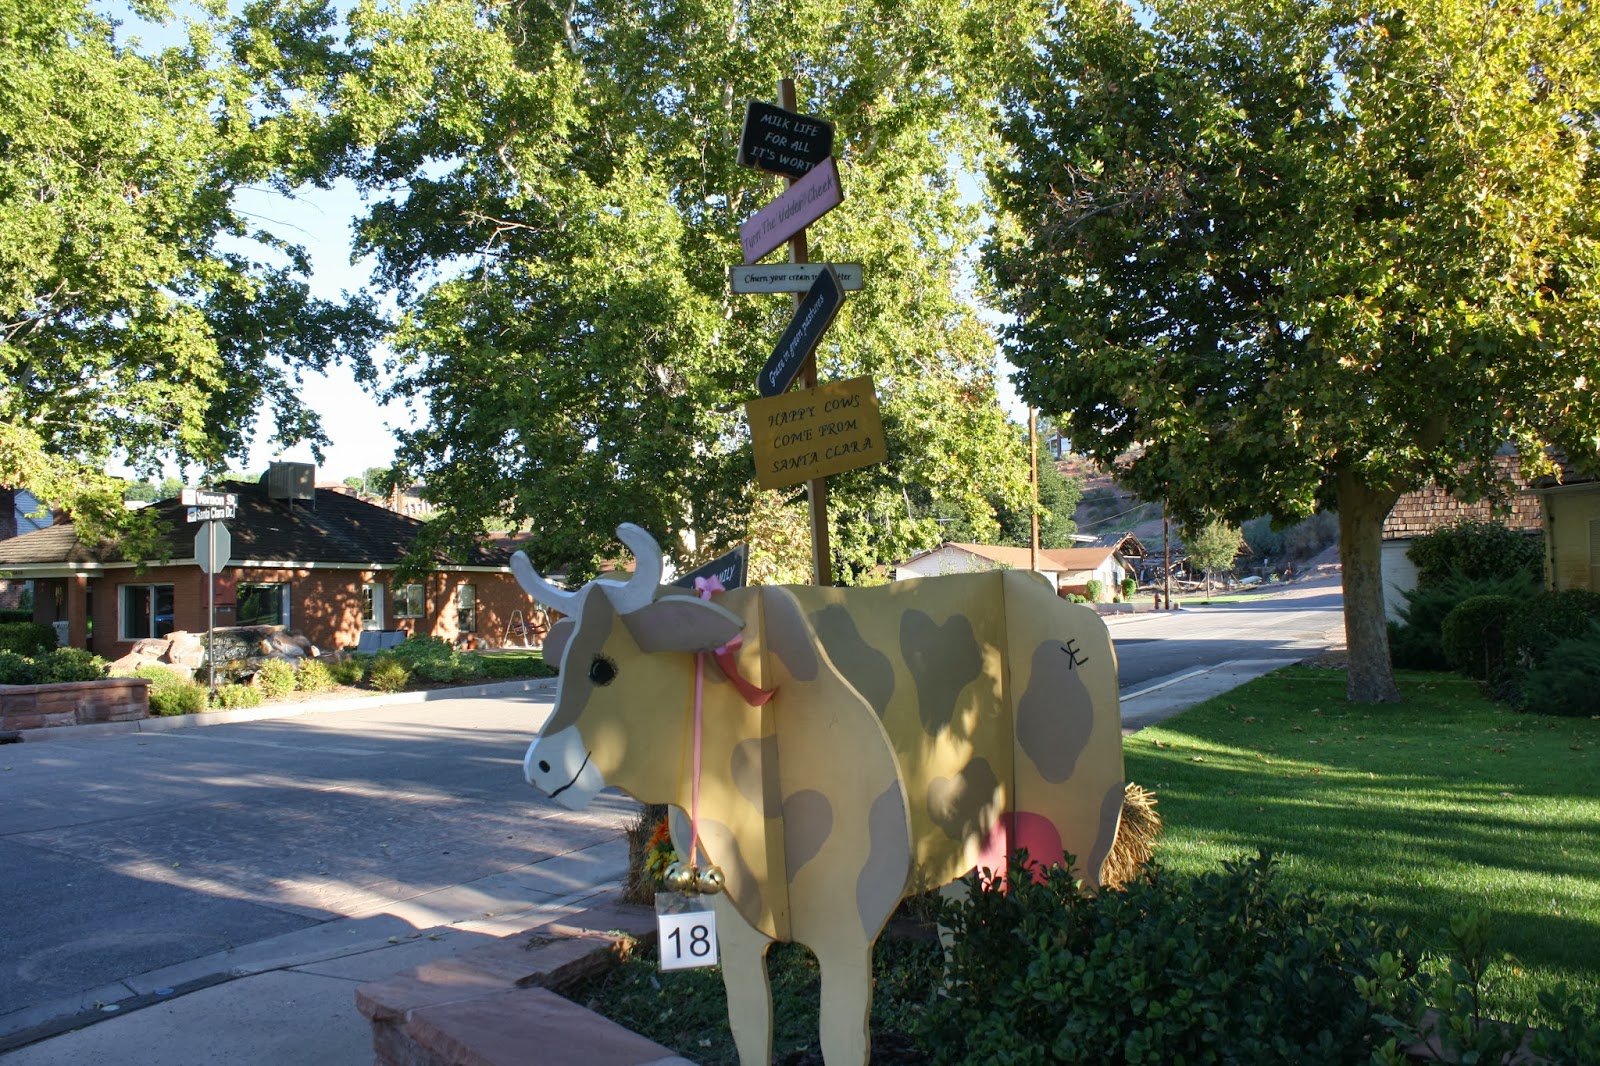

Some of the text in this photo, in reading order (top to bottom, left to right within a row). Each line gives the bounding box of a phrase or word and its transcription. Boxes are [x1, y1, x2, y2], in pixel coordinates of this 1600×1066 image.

[760, 113, 820, 137] MILK LIFE
[750, 146, 776, 160] IT'S
[764, 131, 811, 153] FOR ALL
[744, 229, 762, 251] Turn
[762, 216, 777, 234] The
[807, 174, 833, 204] Cheek
[744, 272, 768, 284] Churn
[768, 274, 788, 285] your
[788, 273, 811, 281] cream
[768, 294, 825, 388] Graze in green pastures
[768, 394, 860, 428] HAPPY COWS
[773, 419, 858, 449] COME FROM
[771, 437, 873, 473] SANTA CLARA
[196, 491, 225, 506] Vernon
[197, 507, 210, 520] Santa
[210, 506, 225, 519] Clara
[668, 924, 711, 959] 18
